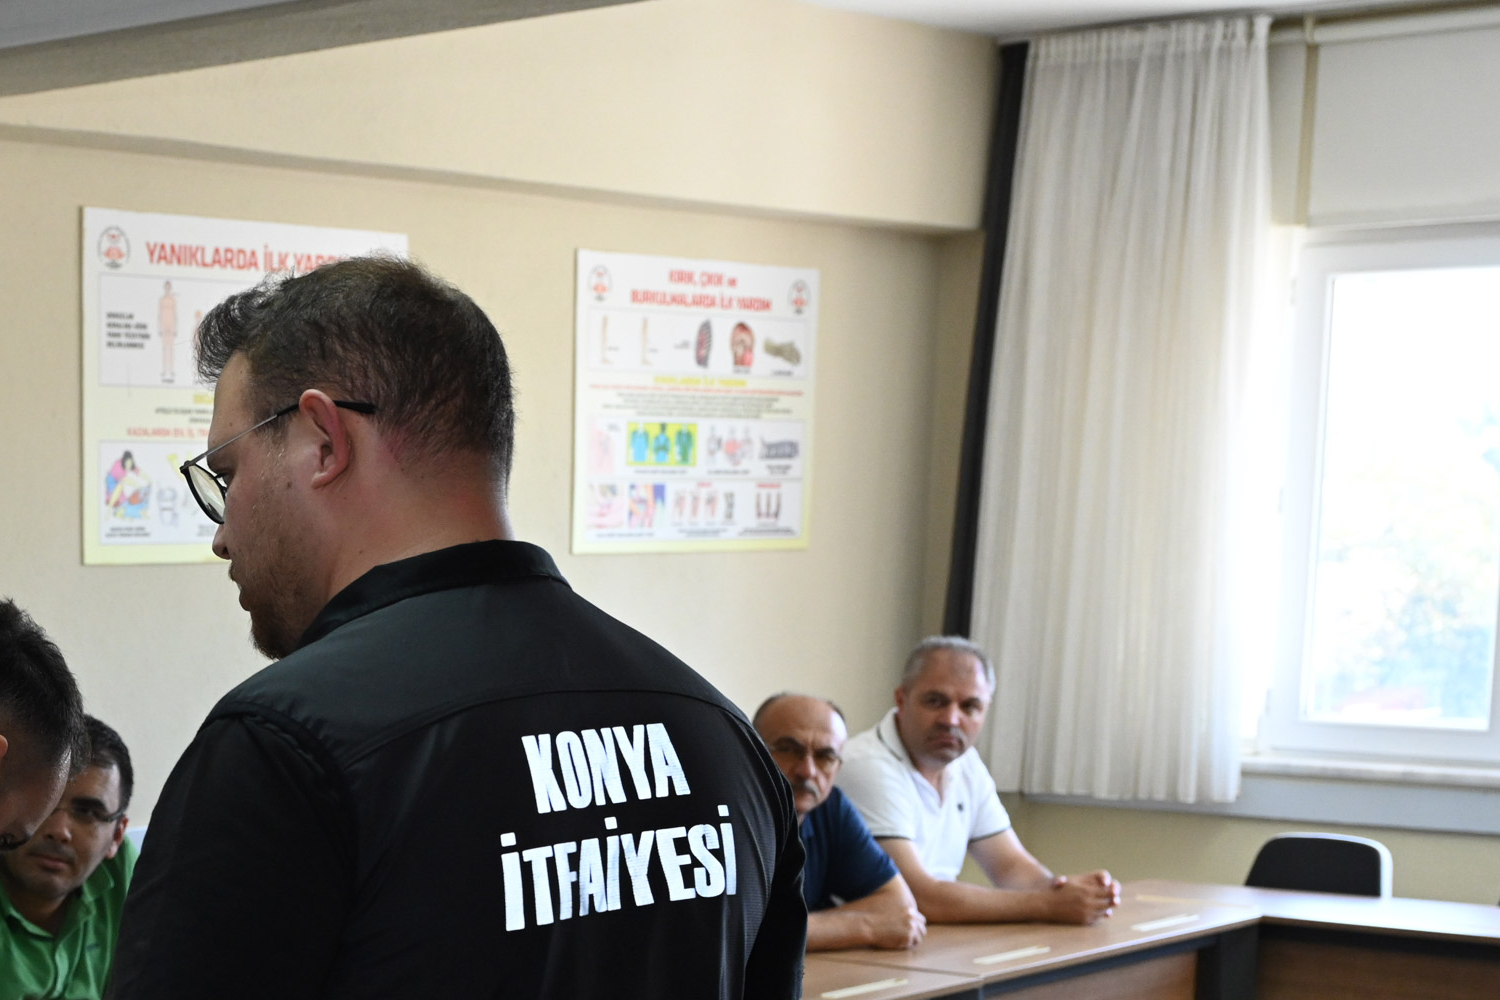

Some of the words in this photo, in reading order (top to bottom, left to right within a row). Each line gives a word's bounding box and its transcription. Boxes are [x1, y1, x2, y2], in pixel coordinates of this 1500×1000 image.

[145, 241, 259, 271] YANIKLARDA
[263, 243, 289, 273] İLK
[521, 722, 691, 814] KONYA
[500, 804, 737, 932] İTFAİYESİ
